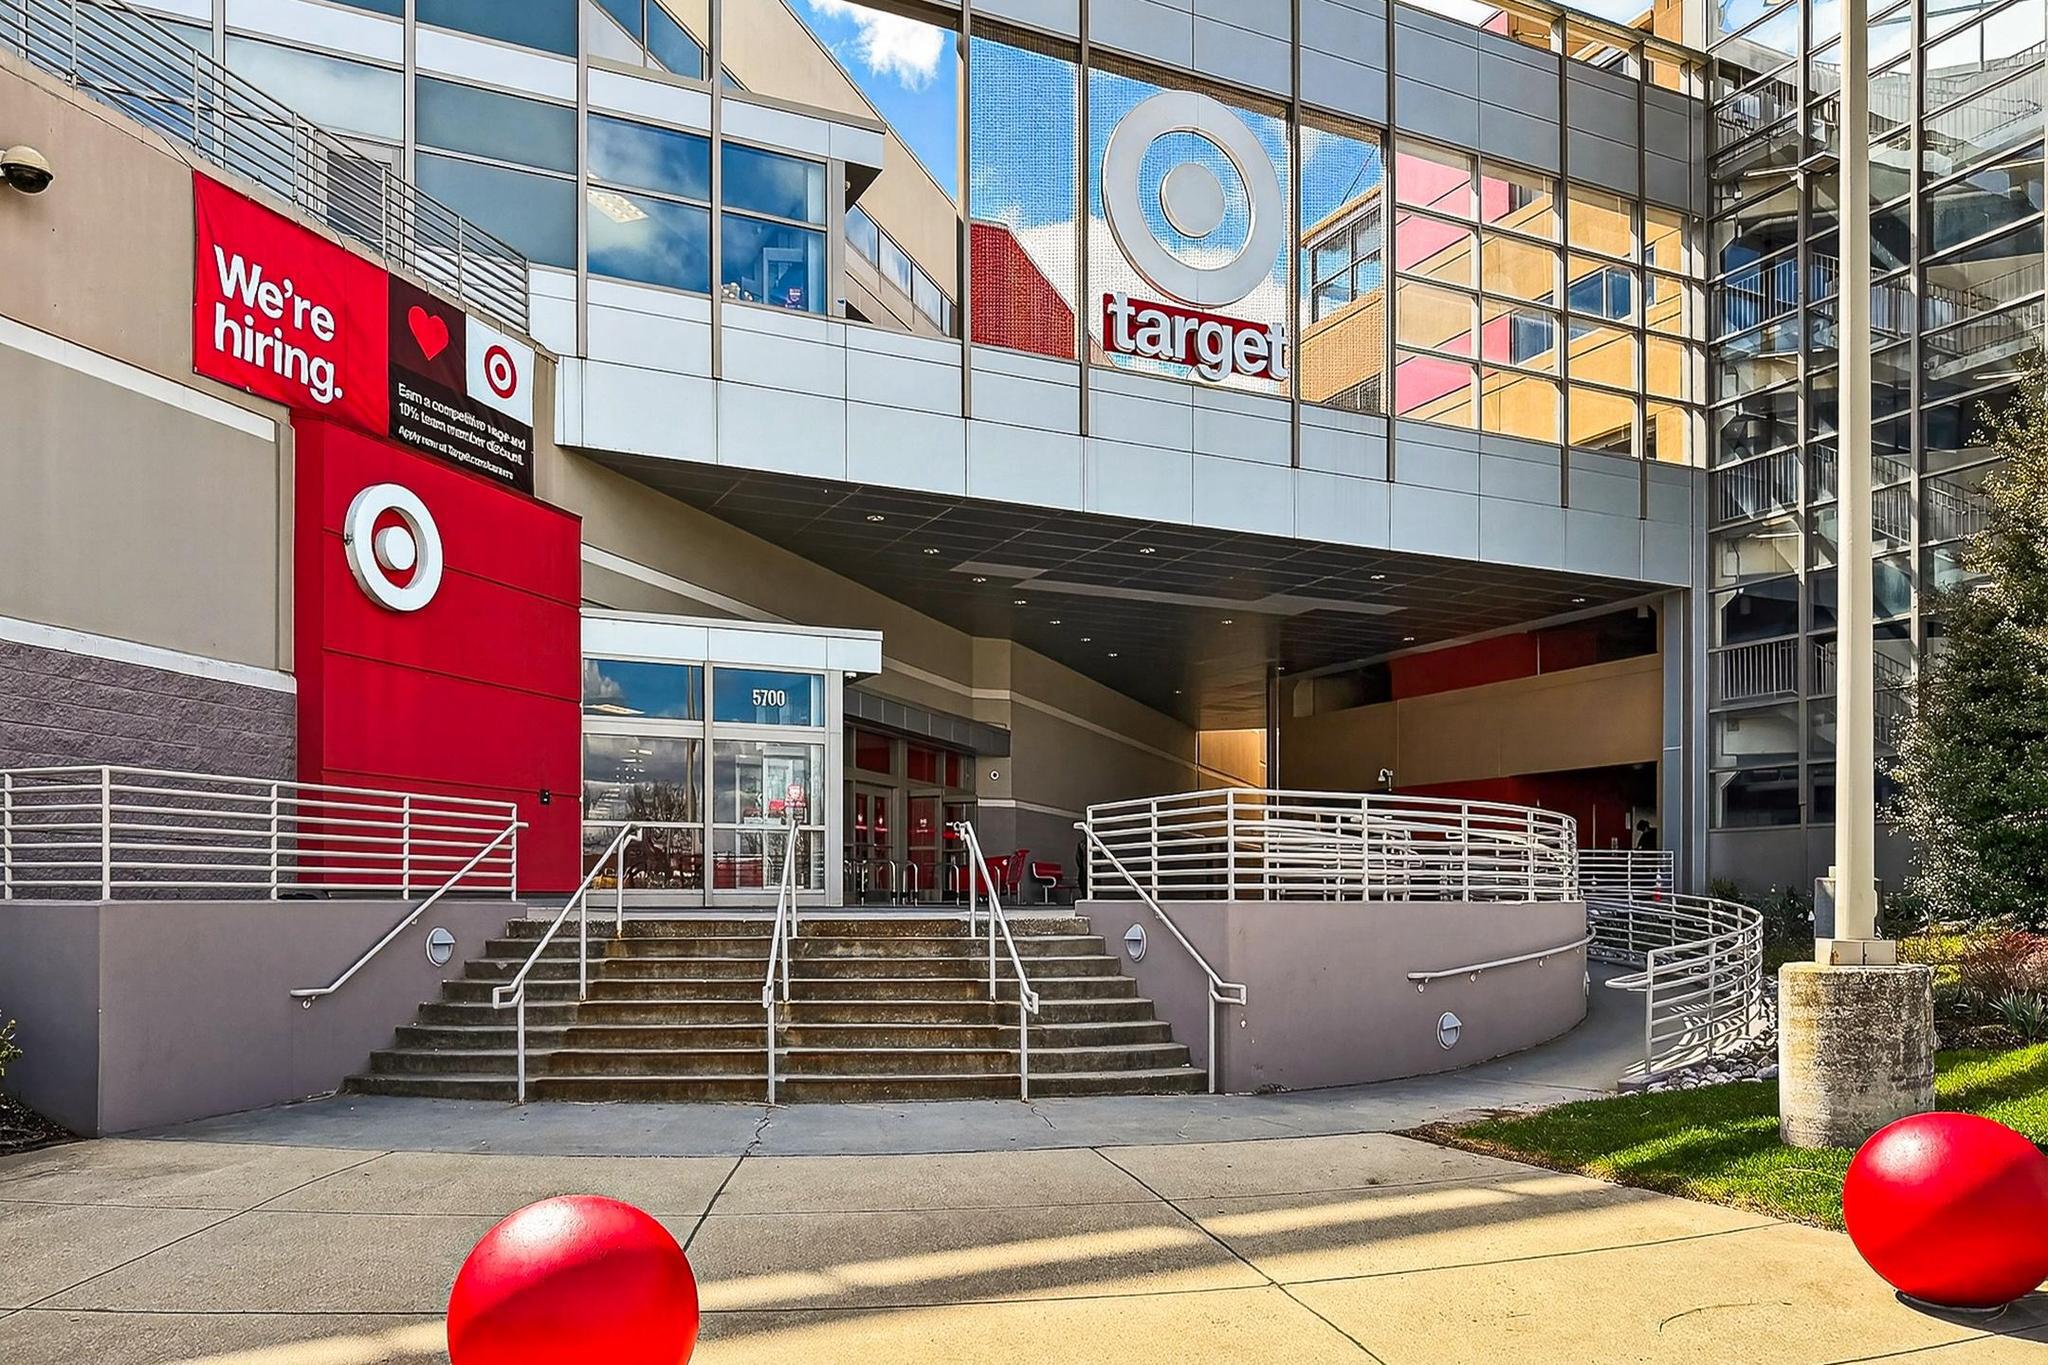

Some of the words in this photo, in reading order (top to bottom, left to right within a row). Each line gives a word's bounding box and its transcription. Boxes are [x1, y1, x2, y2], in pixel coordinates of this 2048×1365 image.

[213, 244, 336, 342] We're
[213, 301, 344, 404] hiring.
[1107, 292, 1289, 381] target
[398, 382, 423, 405] Earn
[423, 397, 431, 408] a
[398, 402, 420, 421] 10%
[752, 689, 786, 706] 5700
